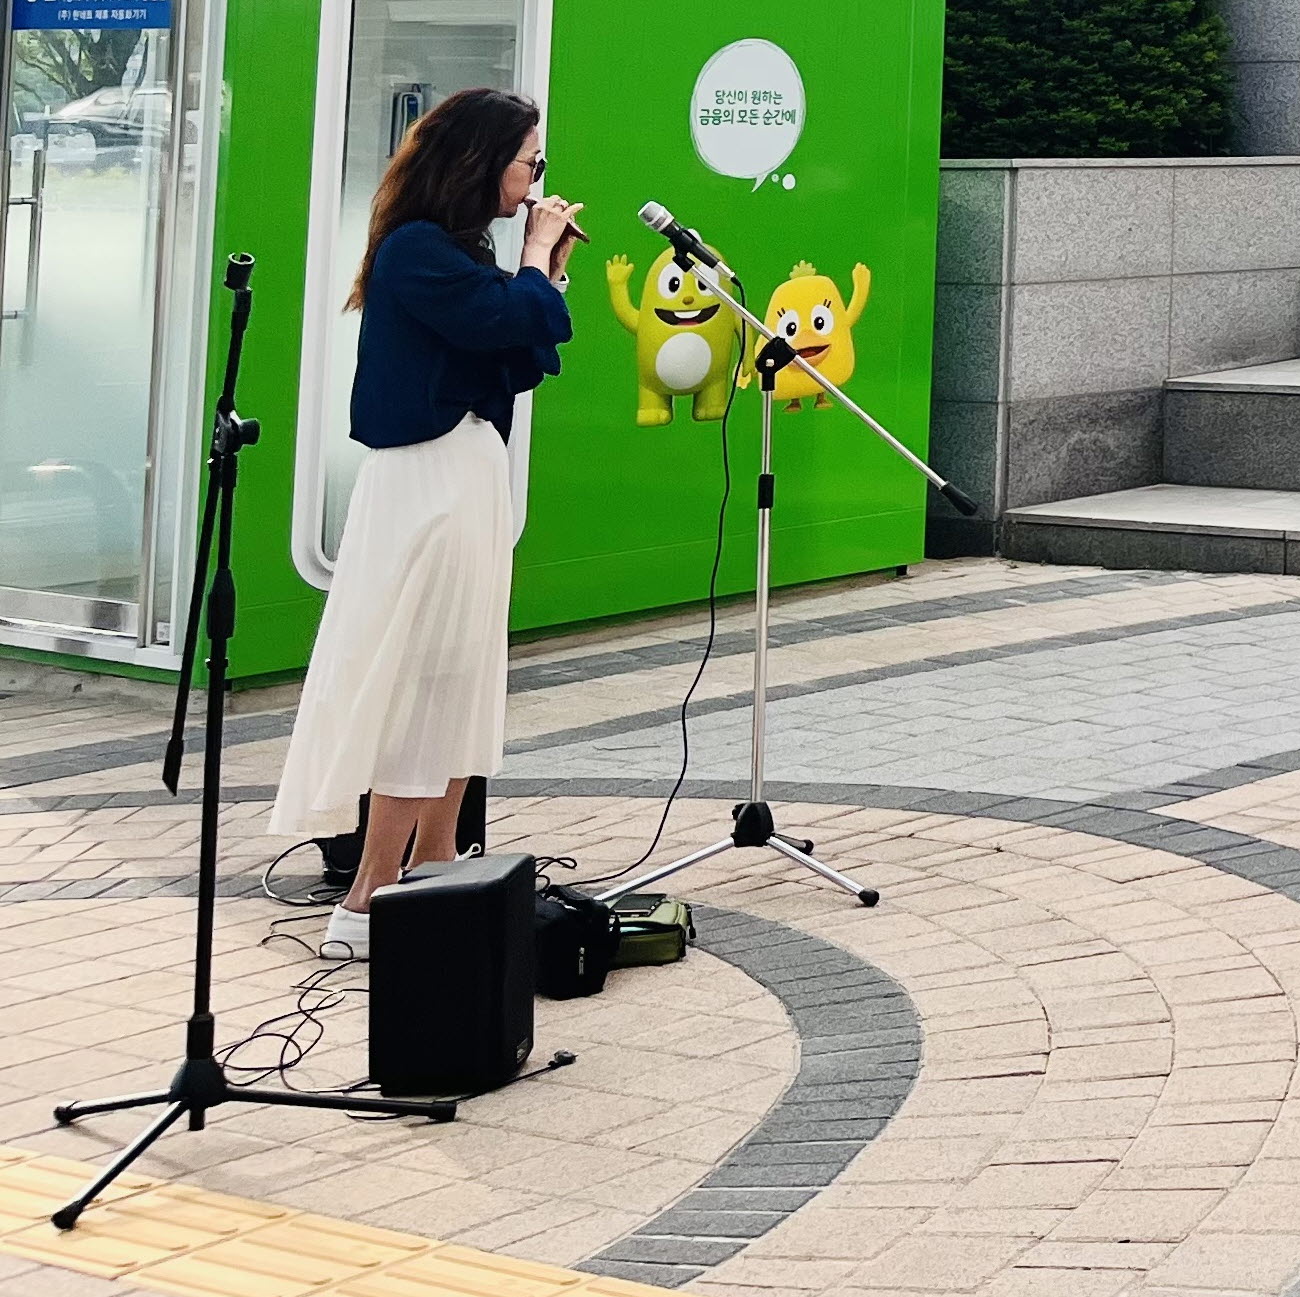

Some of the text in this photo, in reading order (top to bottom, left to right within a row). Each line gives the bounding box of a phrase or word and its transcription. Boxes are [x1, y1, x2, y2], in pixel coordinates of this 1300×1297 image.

[715, 89, 783, 105] 당신이 원하는
[699, 108, 797, 125] 금융의 모든 순간에
